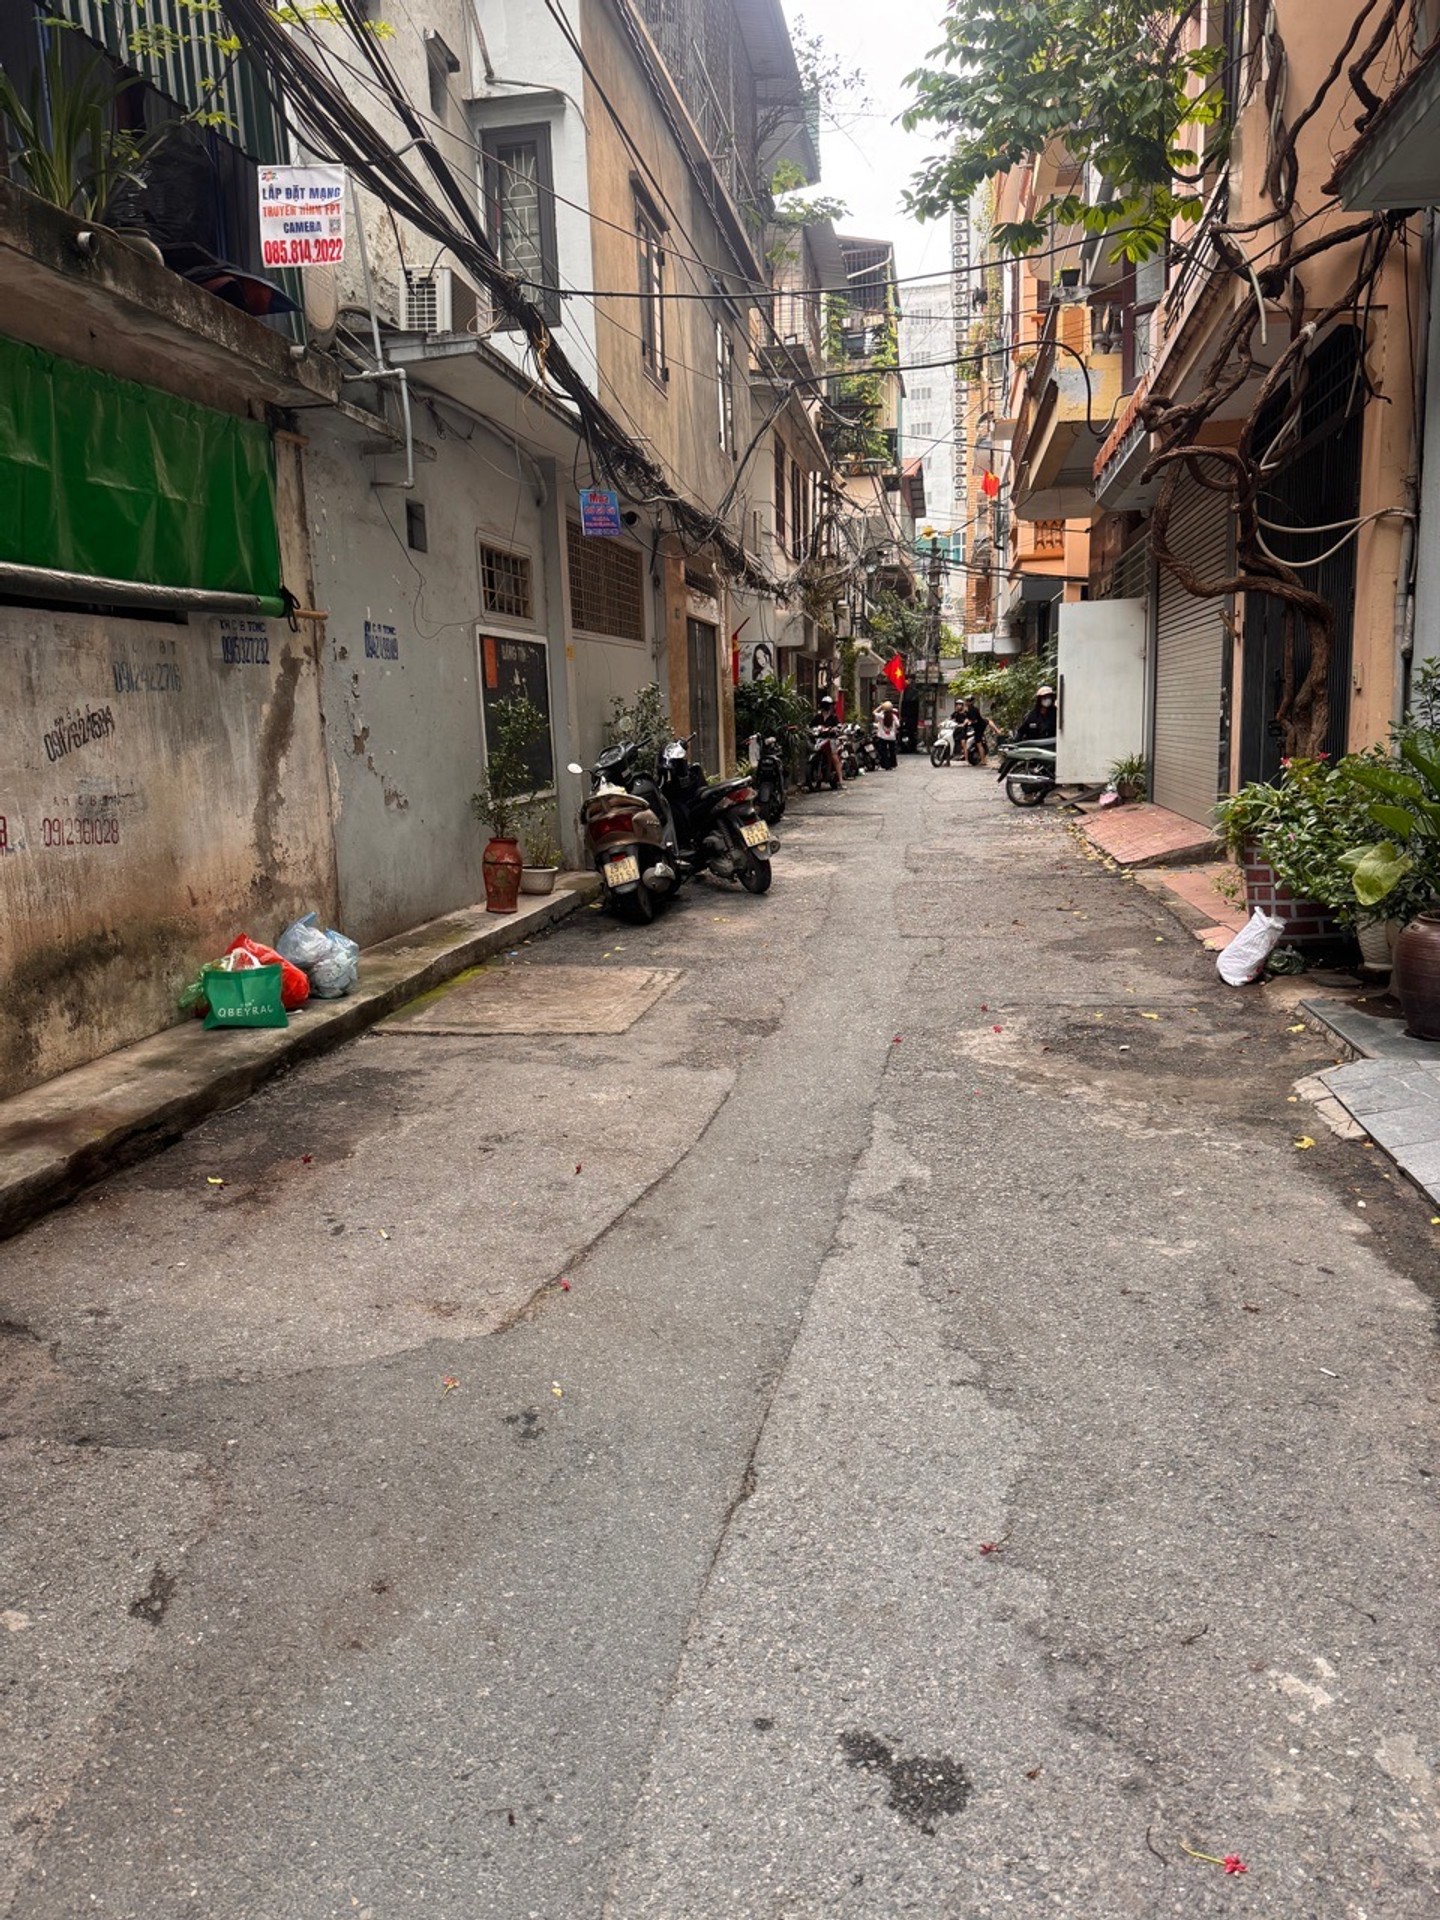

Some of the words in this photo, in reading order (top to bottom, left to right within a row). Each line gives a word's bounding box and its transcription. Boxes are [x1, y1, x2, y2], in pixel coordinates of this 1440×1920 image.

[285, 184, 305, 202] ĐẶT
[309, 187, 341, 201] MẠNG
[325, 203, 341, 215] FPT
[283, 221, 322, 234] CAMERA
[264, 238, 343, 264] 085.814.2022
